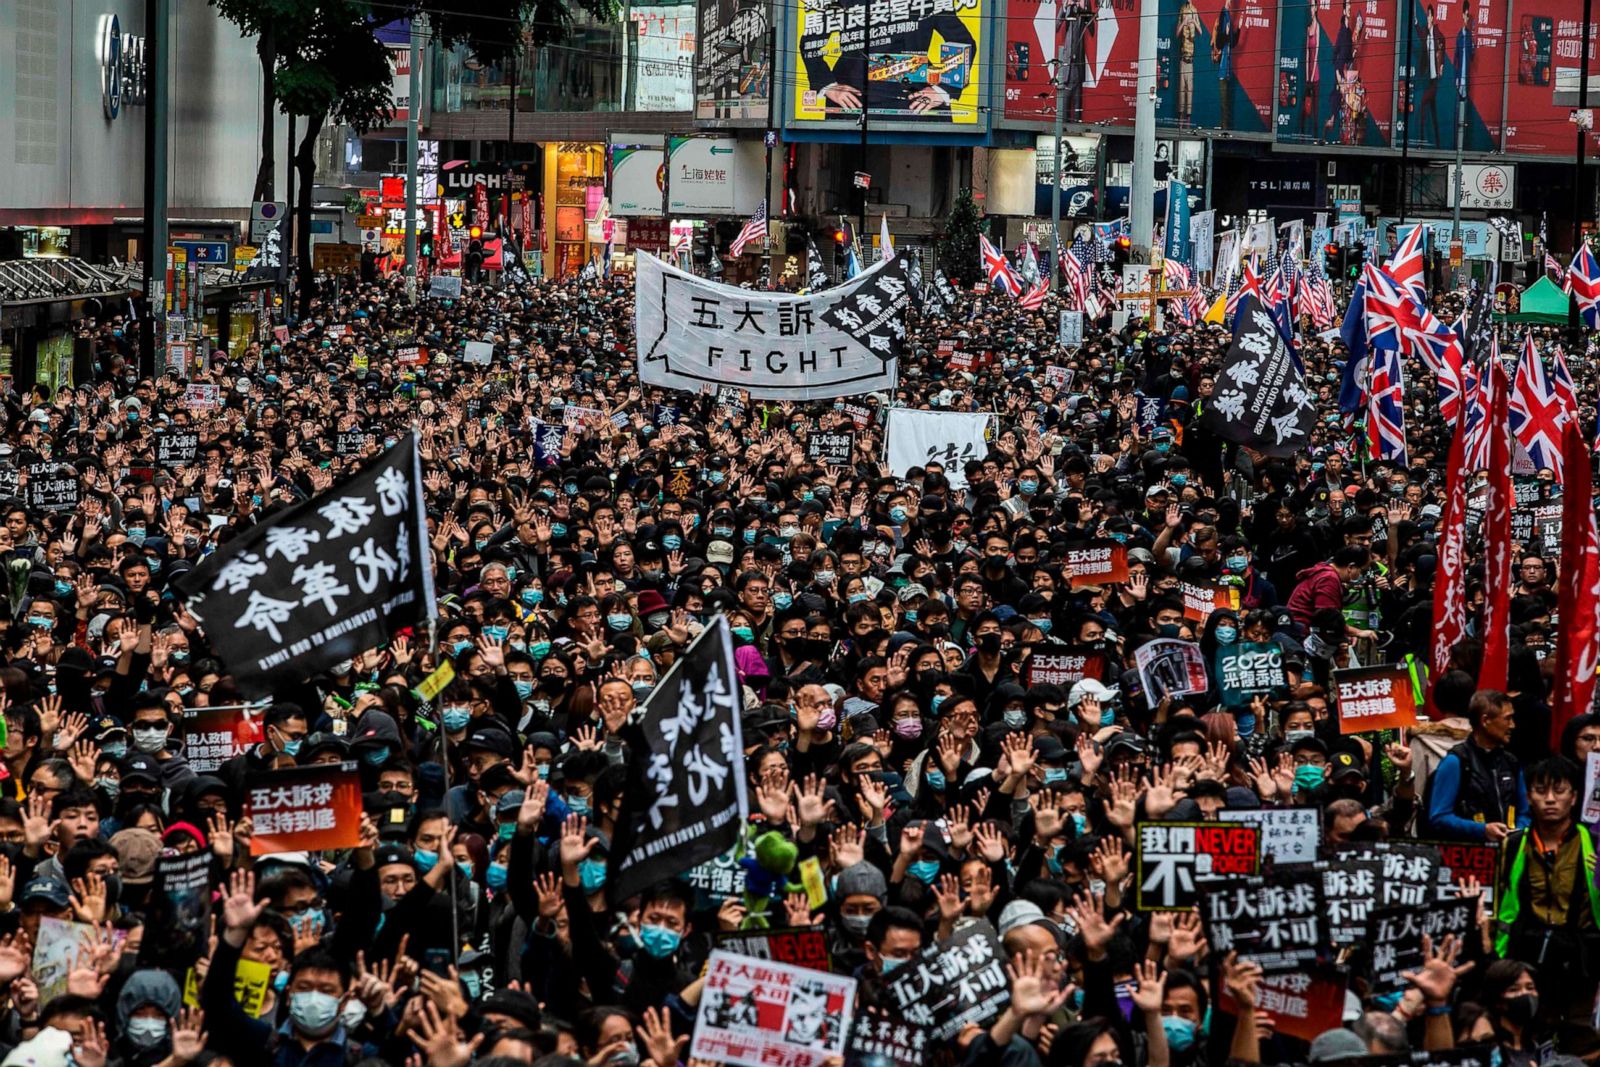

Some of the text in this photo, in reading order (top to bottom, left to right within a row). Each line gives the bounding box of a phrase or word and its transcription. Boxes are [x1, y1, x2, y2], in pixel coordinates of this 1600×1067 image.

[449, 173, 501, 188] LUSH
[689, 296, 816, 337] 五大訴
[708, 346, 848, 375] FIGHT
[810, 434, 850, 447] 五大訴求
[32, 479, 77, 493] 五大訴求
[1067, 548, 1111, 563] 五大訴求
[1033, 654, 1087, 671] 五大訴求
[1222, 653, 1282, 673] 2020
[1339, 678, 1393, 699] 五大訴求
[1341, 696, 1396, 718] 堅持到底
[251, 783, 334, 810] 五大訴求
[251, 807, 336, 836] 堅持到底
[1141, 826, 1195, 853] 我們
[1196, 826, 1257, 854] NEVER
[1382, 853, 1431, 882] 訴求
[1440, 847, 1496, 868] NEVER
[1322, 869, 1376, 897] 訴求
[1207, 882, 1317, 921] 五大訴求
[1326, 898, 1376, 925] 不可
[1209, 915, 1319, 951] 缺一不可
[1377, 905, 1469, 944] 五大訴求
[891, 933, 994, 1010] 五大訴求
[902, 958, 1007, 1026] 缺一不可
